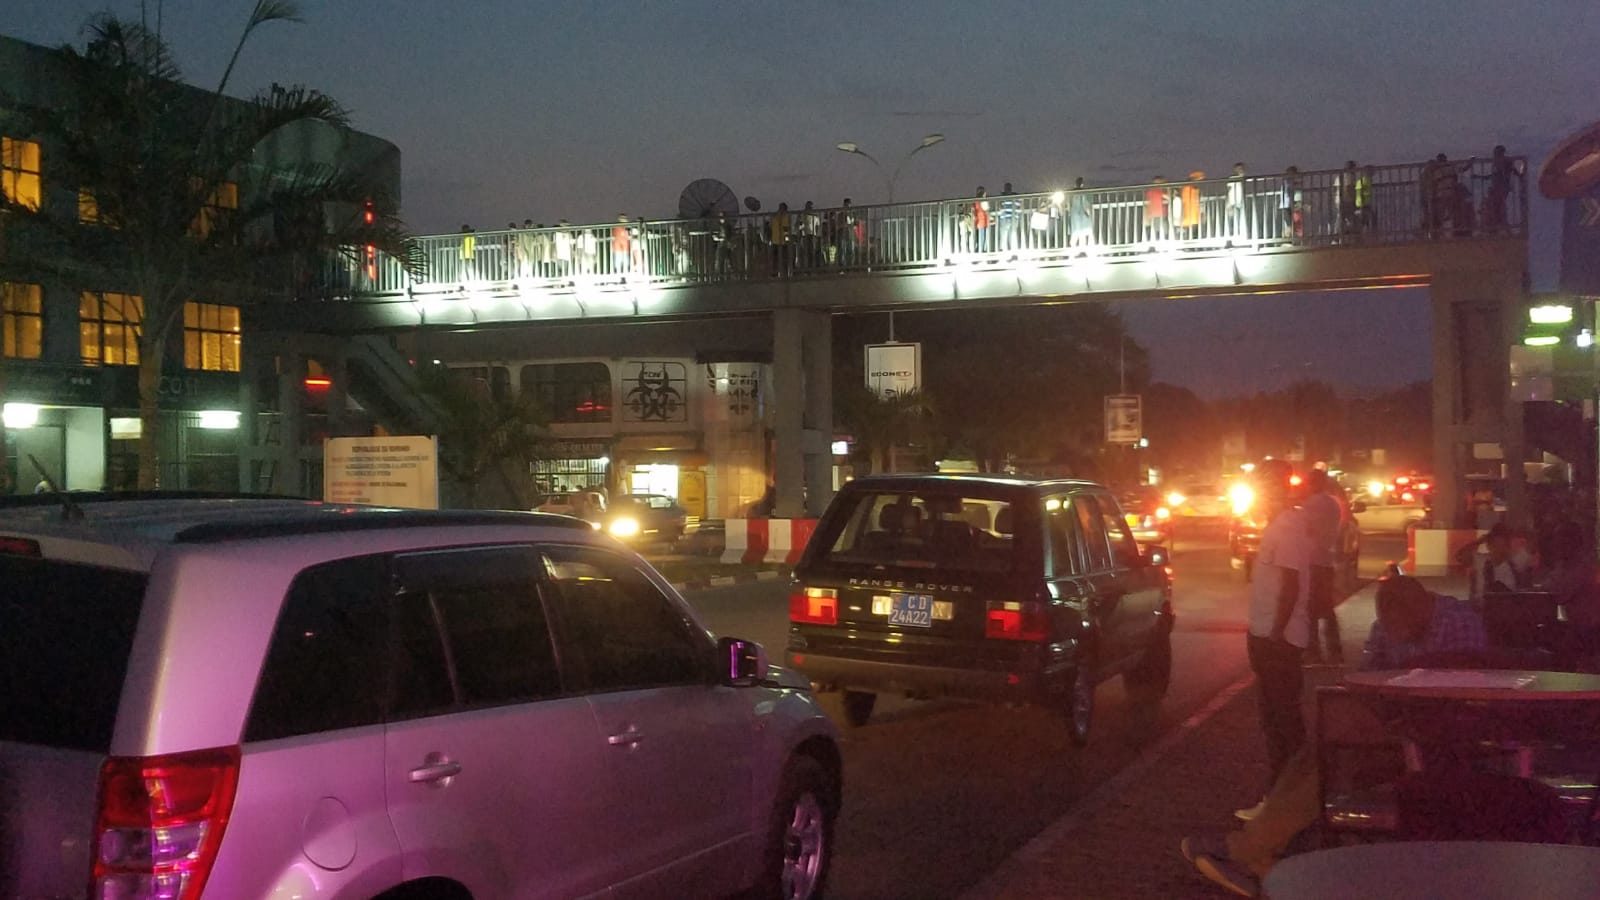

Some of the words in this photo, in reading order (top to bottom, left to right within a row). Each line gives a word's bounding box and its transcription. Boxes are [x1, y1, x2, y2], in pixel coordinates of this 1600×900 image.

[849, 578, 905, 588] RANGE
[915, 584, 973, 592] ROVER
[891, 610, 928, 624] 24A22
